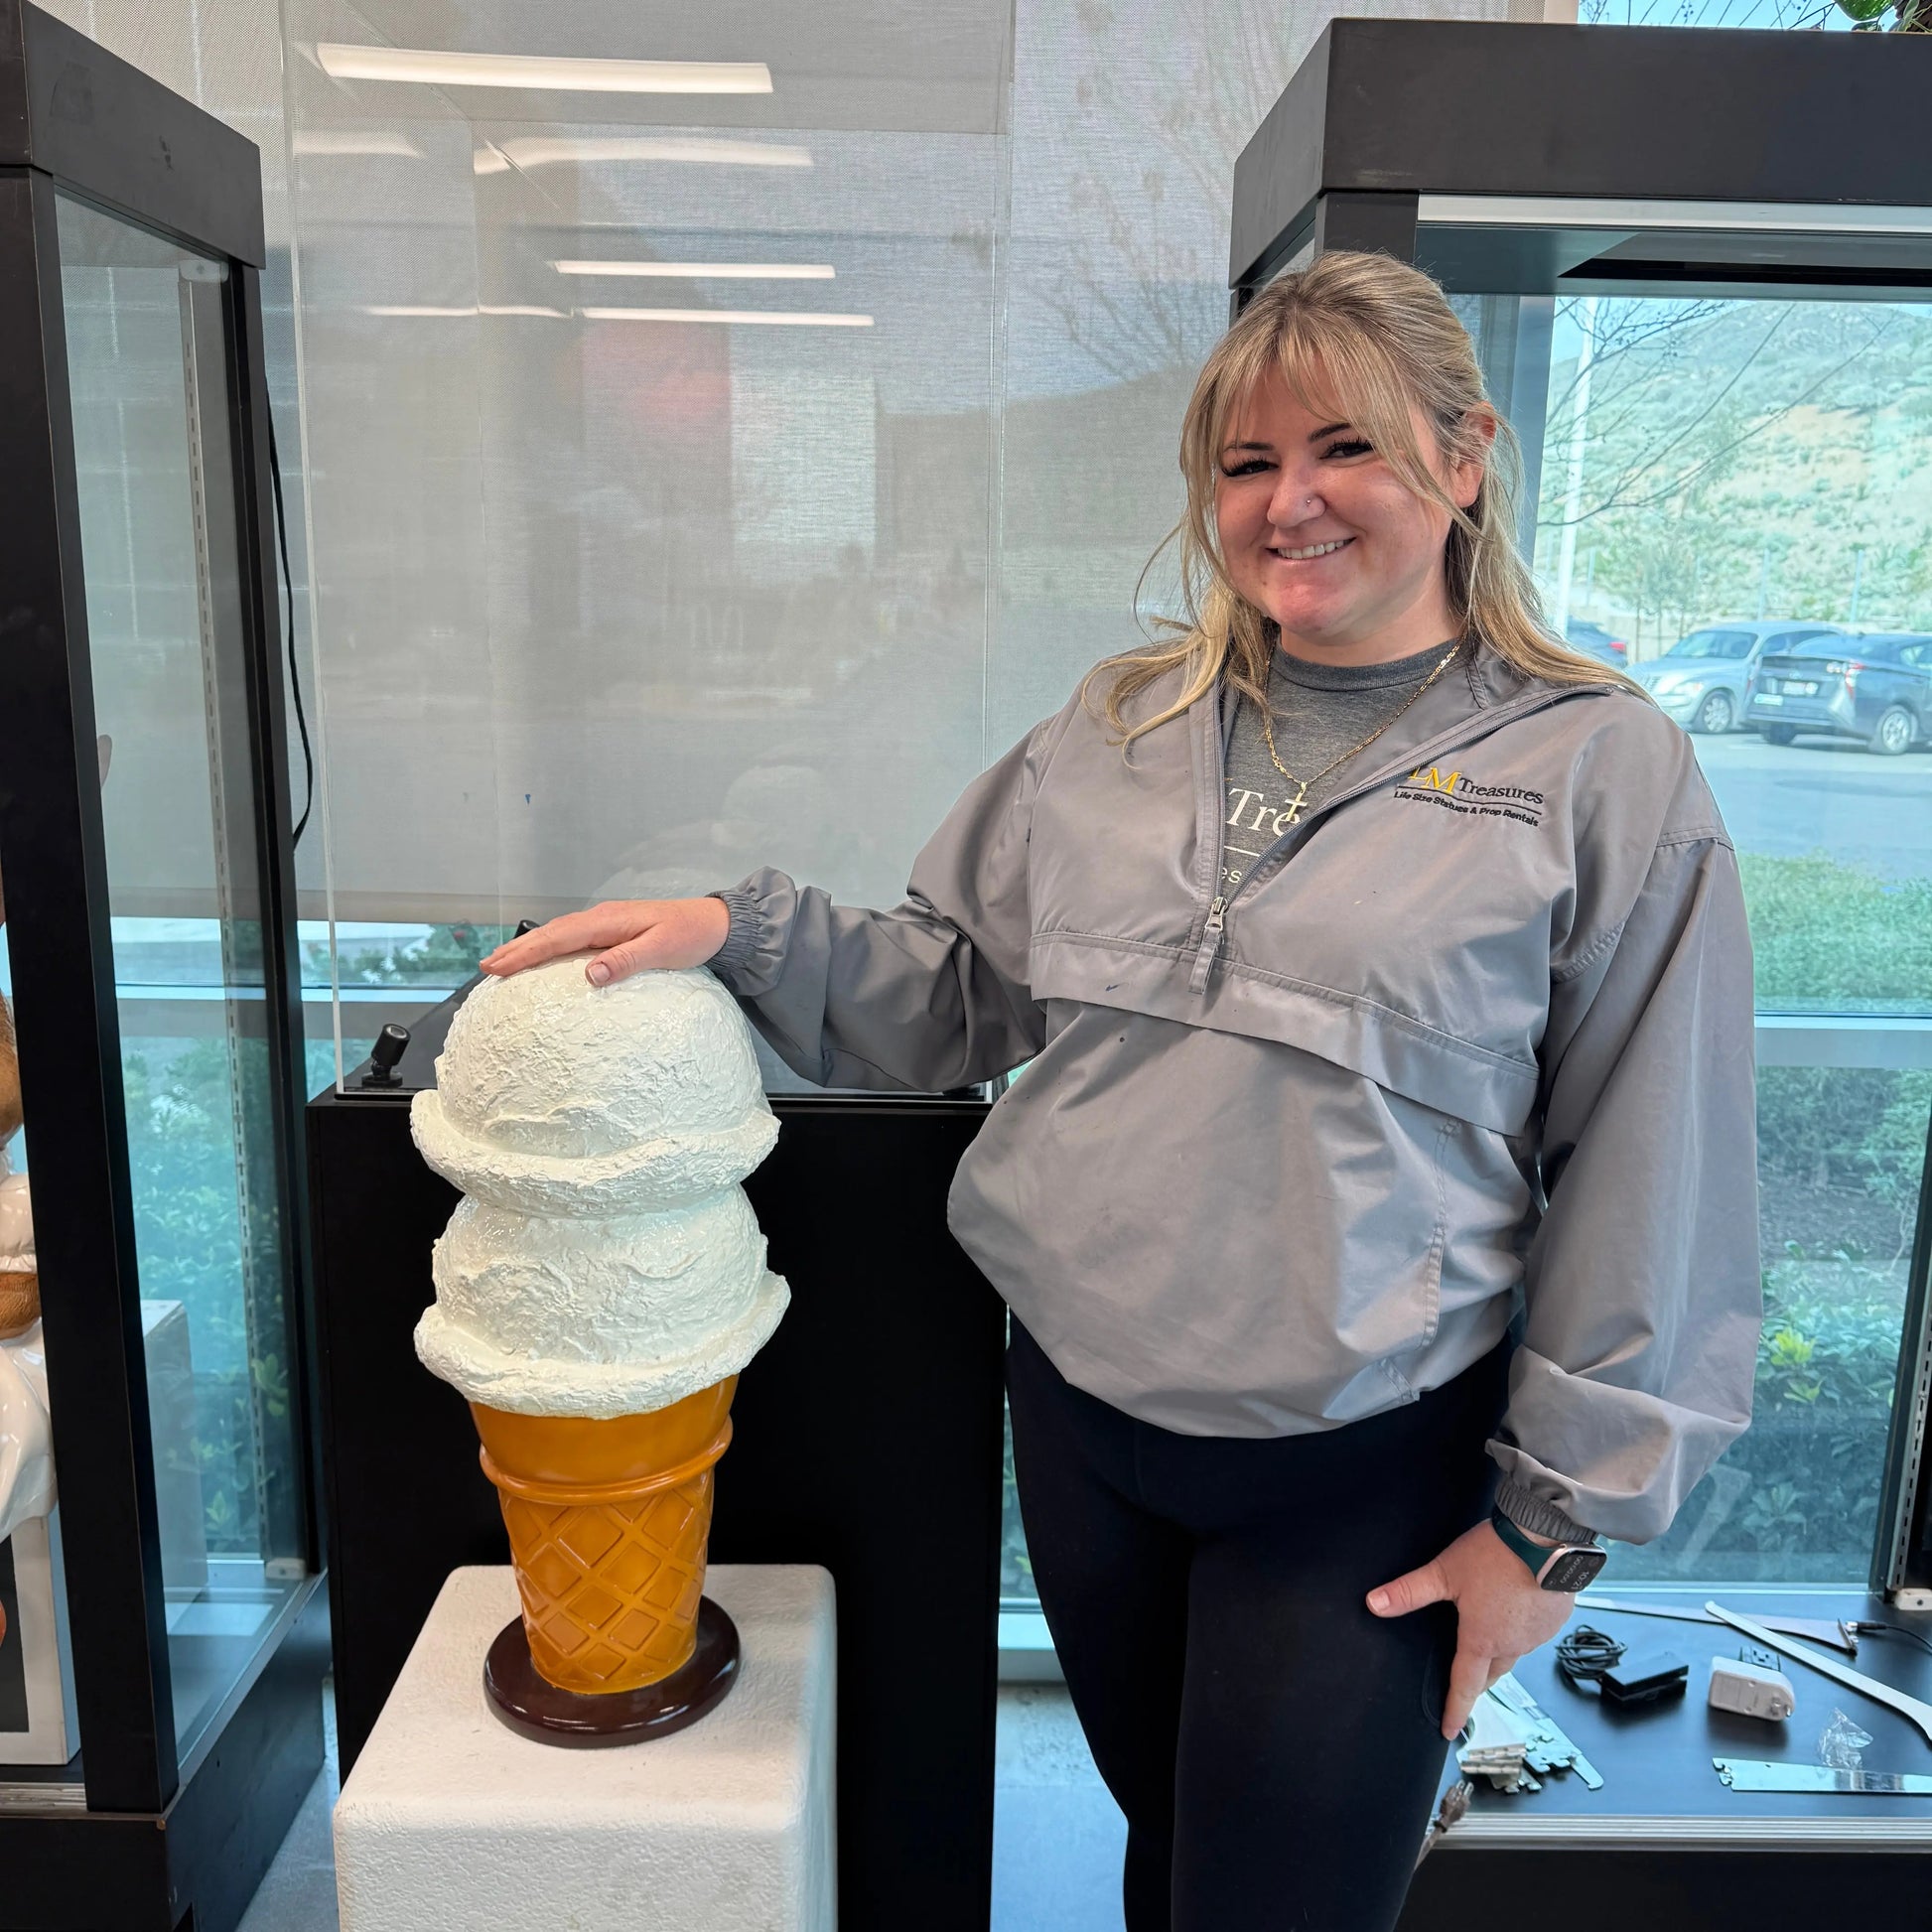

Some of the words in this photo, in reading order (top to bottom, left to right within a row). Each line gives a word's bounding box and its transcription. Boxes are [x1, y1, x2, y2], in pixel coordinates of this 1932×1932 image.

[1412, 793, 1433, 803] Size
[1433, 796, 1468, 814] Statues
[1479, 807, 1501, 816] Prop
[1503, 810, 1539, 827] Rentals
